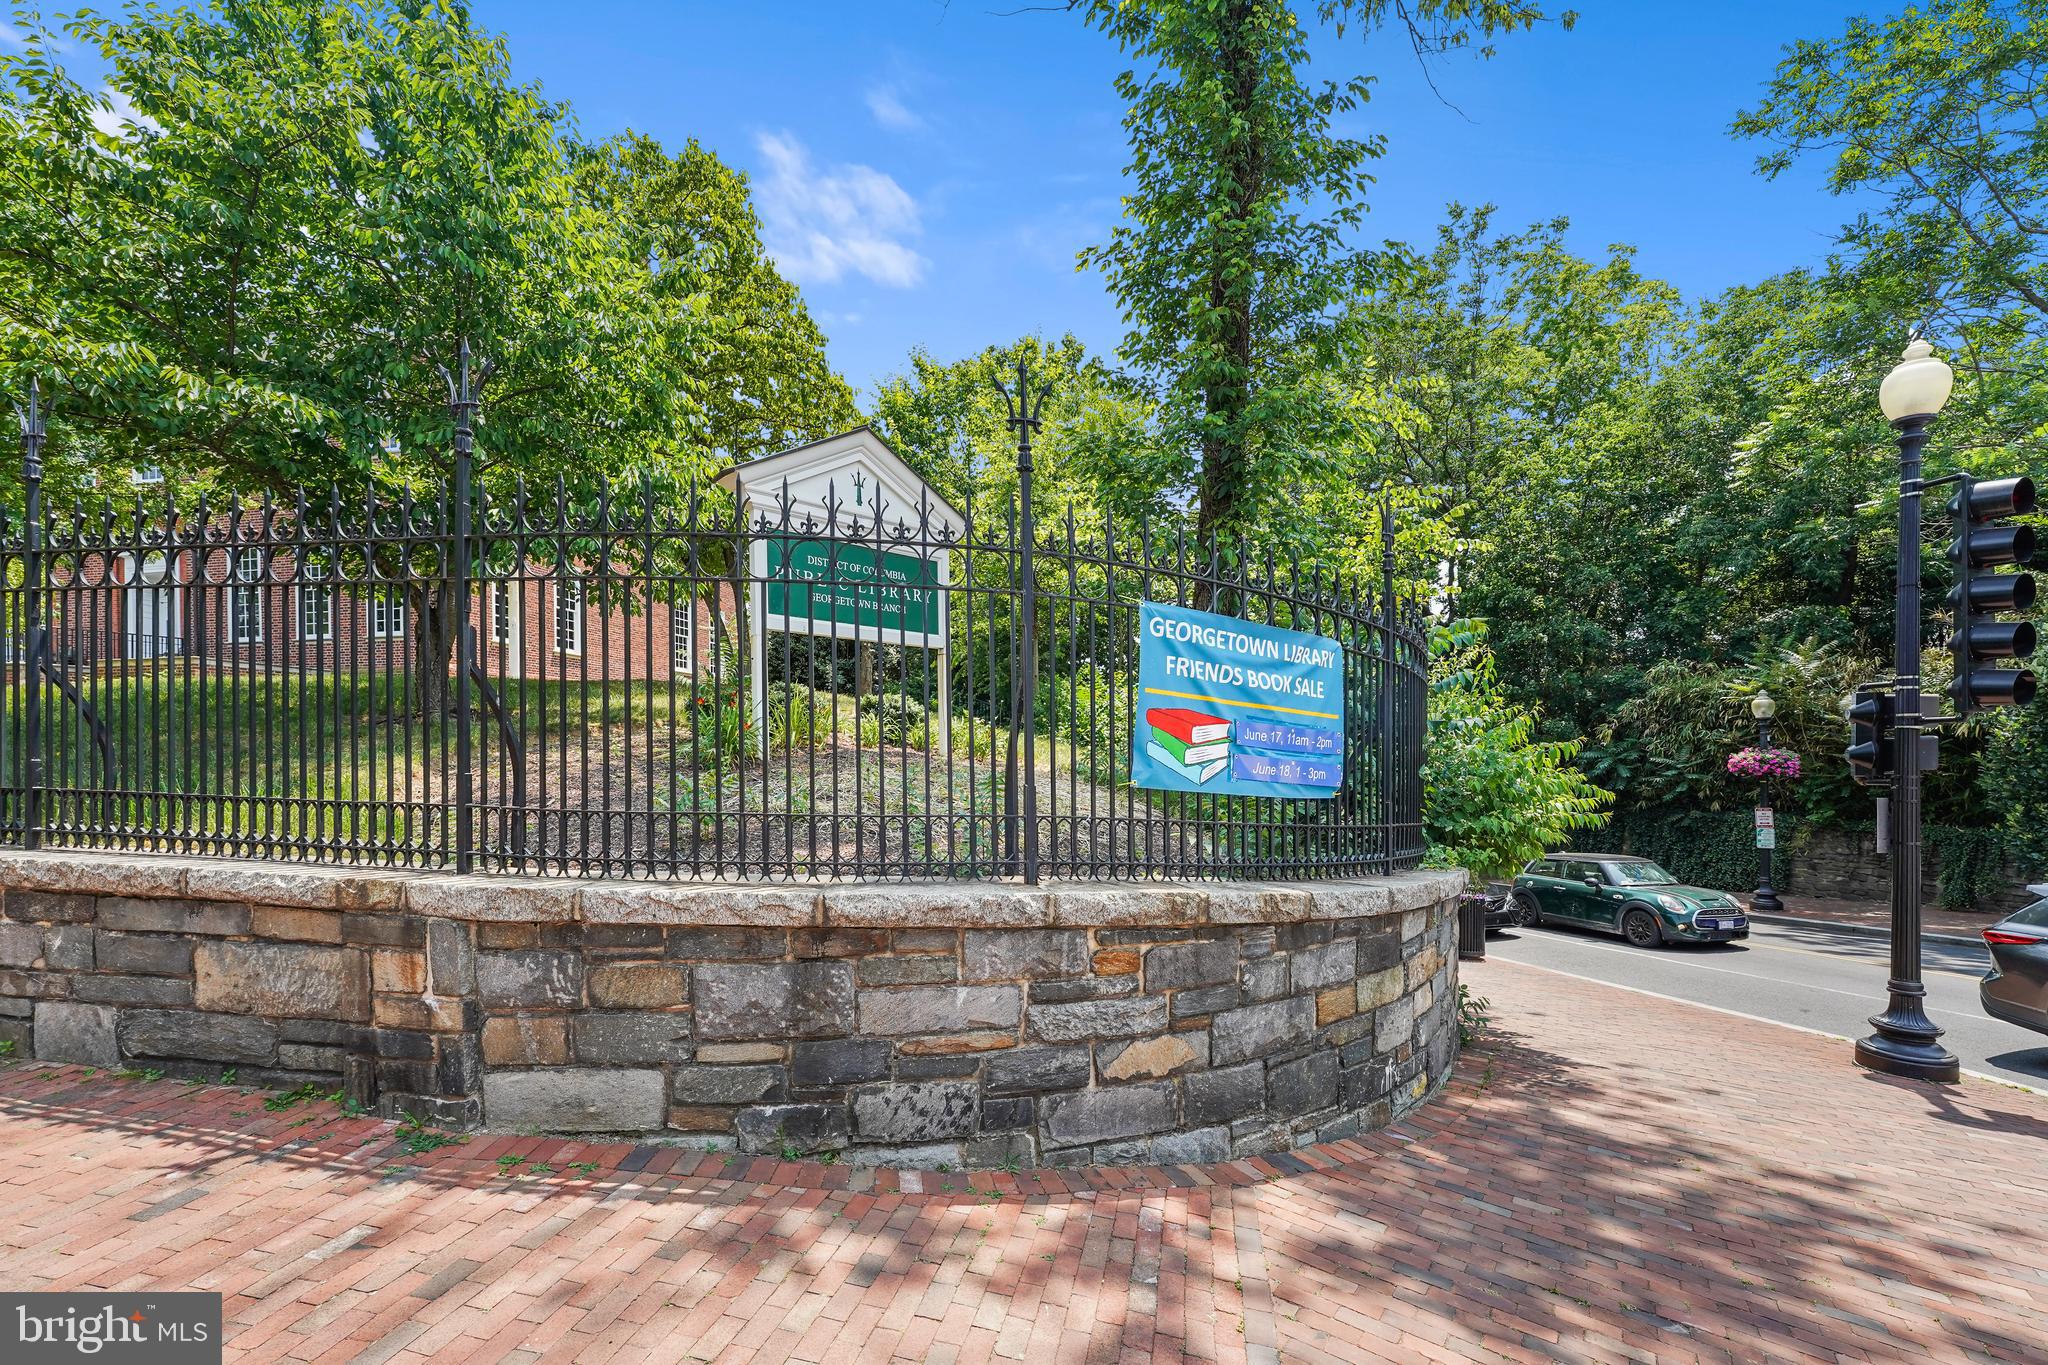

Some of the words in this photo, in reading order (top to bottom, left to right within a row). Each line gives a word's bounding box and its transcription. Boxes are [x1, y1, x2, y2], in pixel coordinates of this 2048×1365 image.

[807, 555, 848, 571] DISTCT
[850, 563, 861, 573] OF
[775, 565, 849, 591] PUBLC
[872, 602, 907, 614] BANC
[1149, 616, 1279, 660] GEORGETOWN
[1284, 643, 1335, 669] LIBRARY
[1166, 655, 1244, 686] FRIENDS
[1247, 669, 1292, 694] BOOK
[1293, 677, 1325, 699] SALE
[1244, 728, 1268, 743] June
[1270, 731, 1284, 745] 17,
[1287, 732, 1309, 746] 11am
[1316, 736, 1333, 750] 2pm
[1252, 762, 1277, 776] June
[1279, 764, 1292, 778] 18,
[1307, 767, 1326, 781] 3pm
